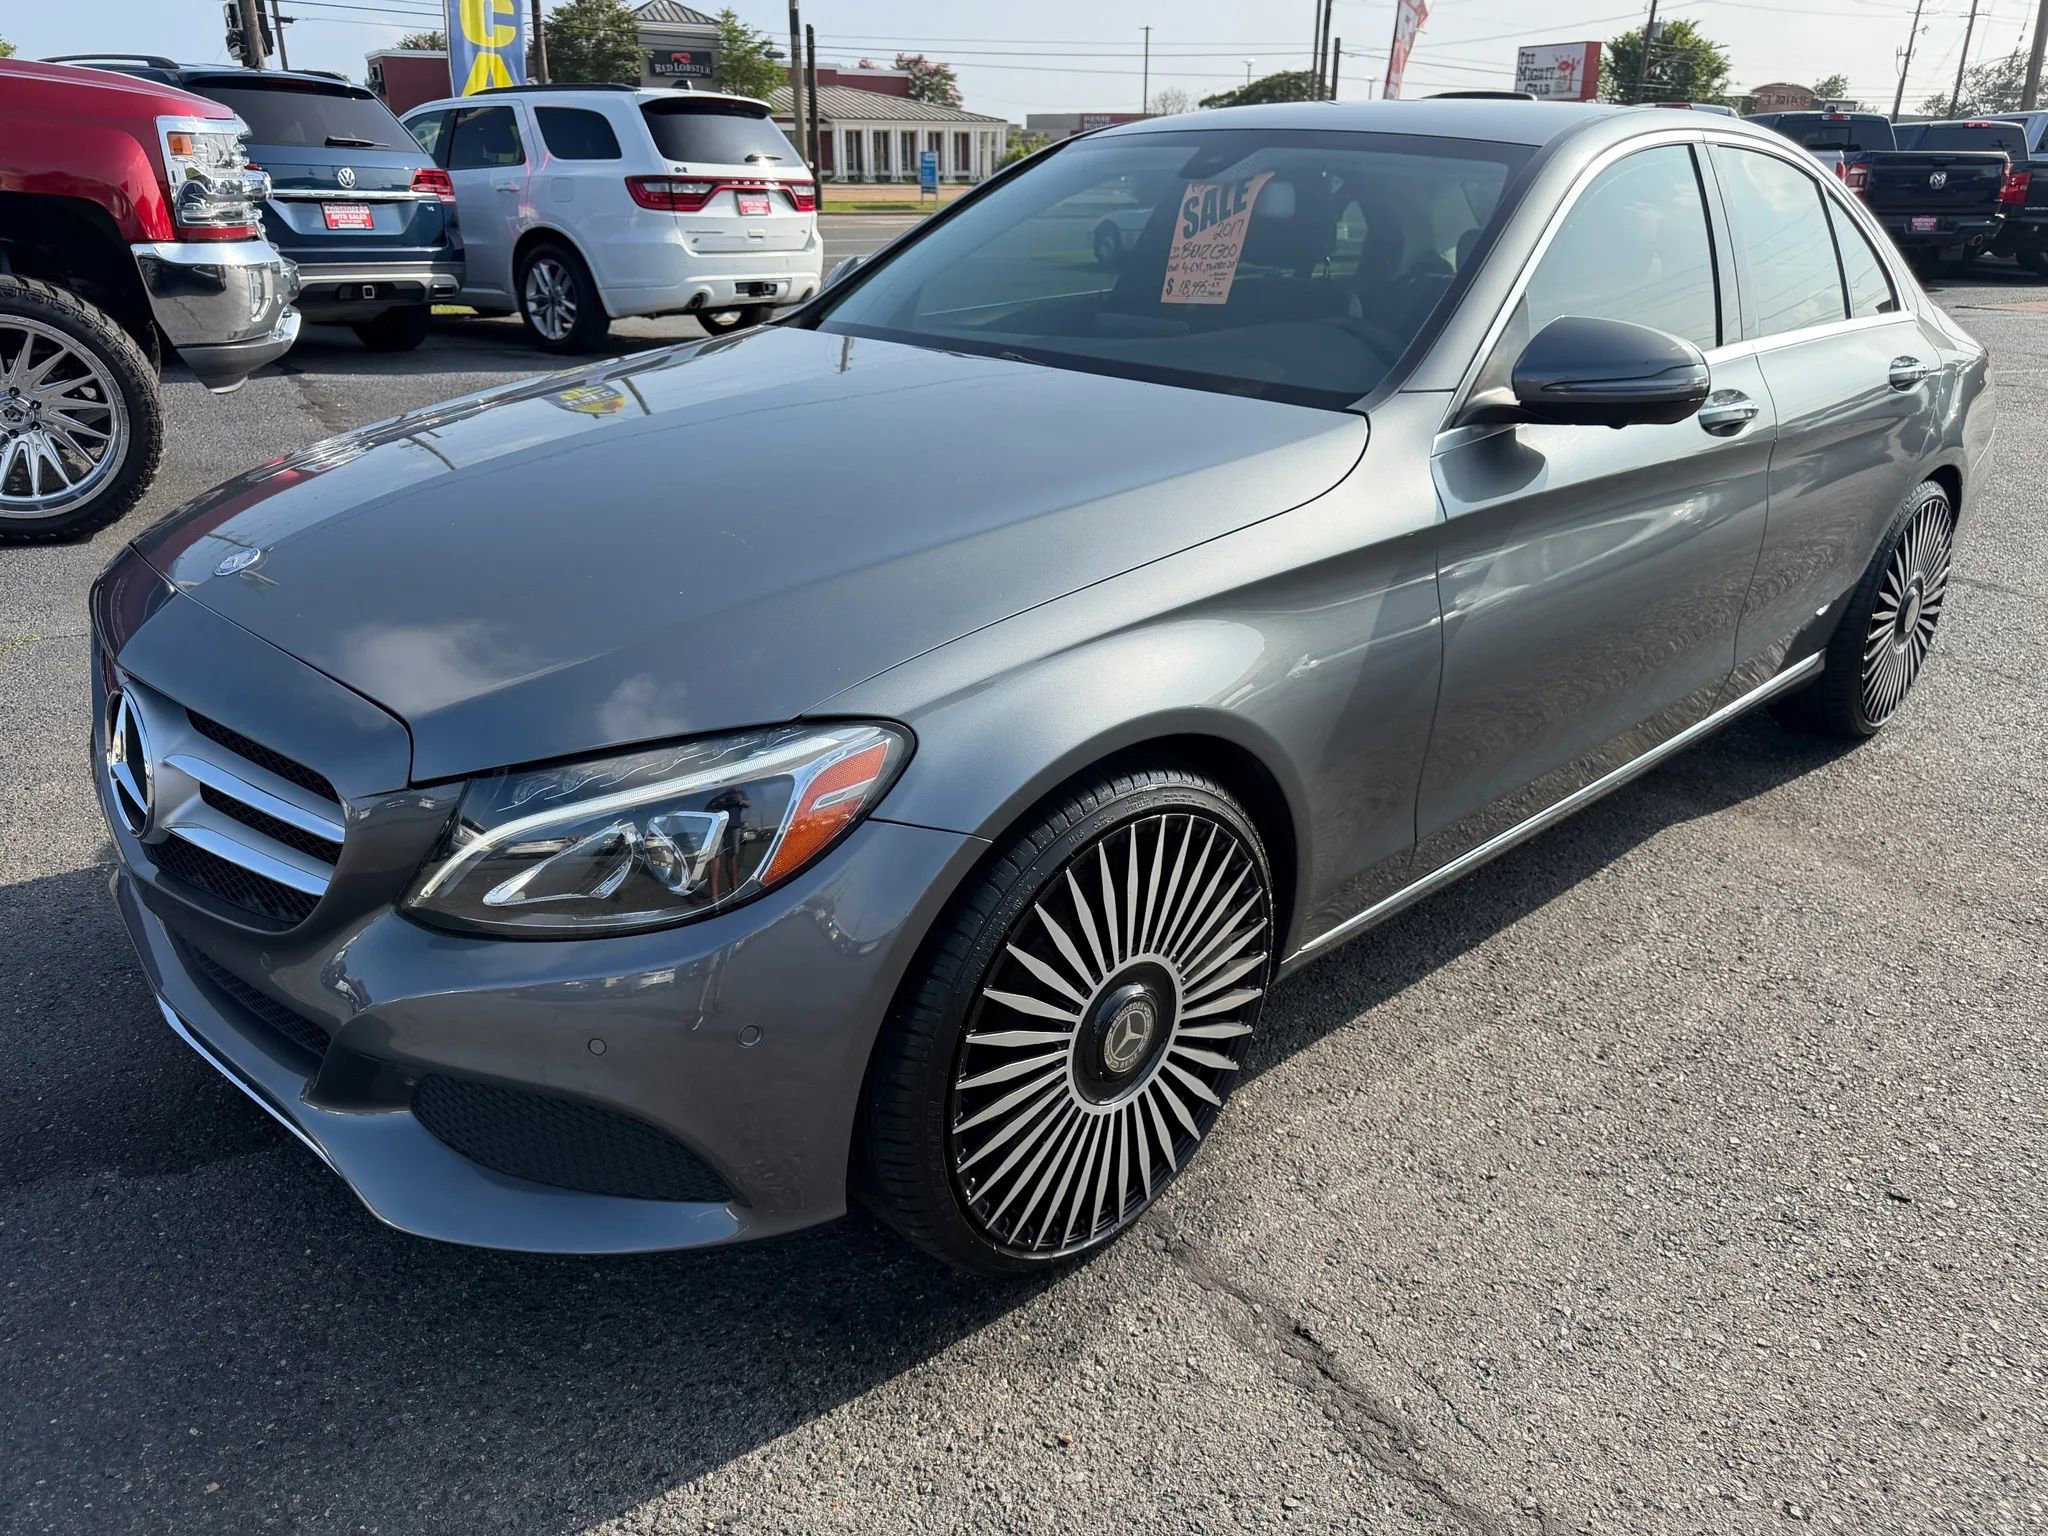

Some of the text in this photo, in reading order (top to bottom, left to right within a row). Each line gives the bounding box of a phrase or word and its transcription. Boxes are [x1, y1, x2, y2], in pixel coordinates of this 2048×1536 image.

[654, 63, 673, 73] RED
[674, 62, 711, 75] LOBSTER
[1519, 66, 1556, 82] MIGHTY
[1183, 181, 1249, 240] SALE
[1213, 219, 1245, 240] 2017
[1181, 242, 1210, 260] BENZ
[1209, 243, 1238, 260] C300
